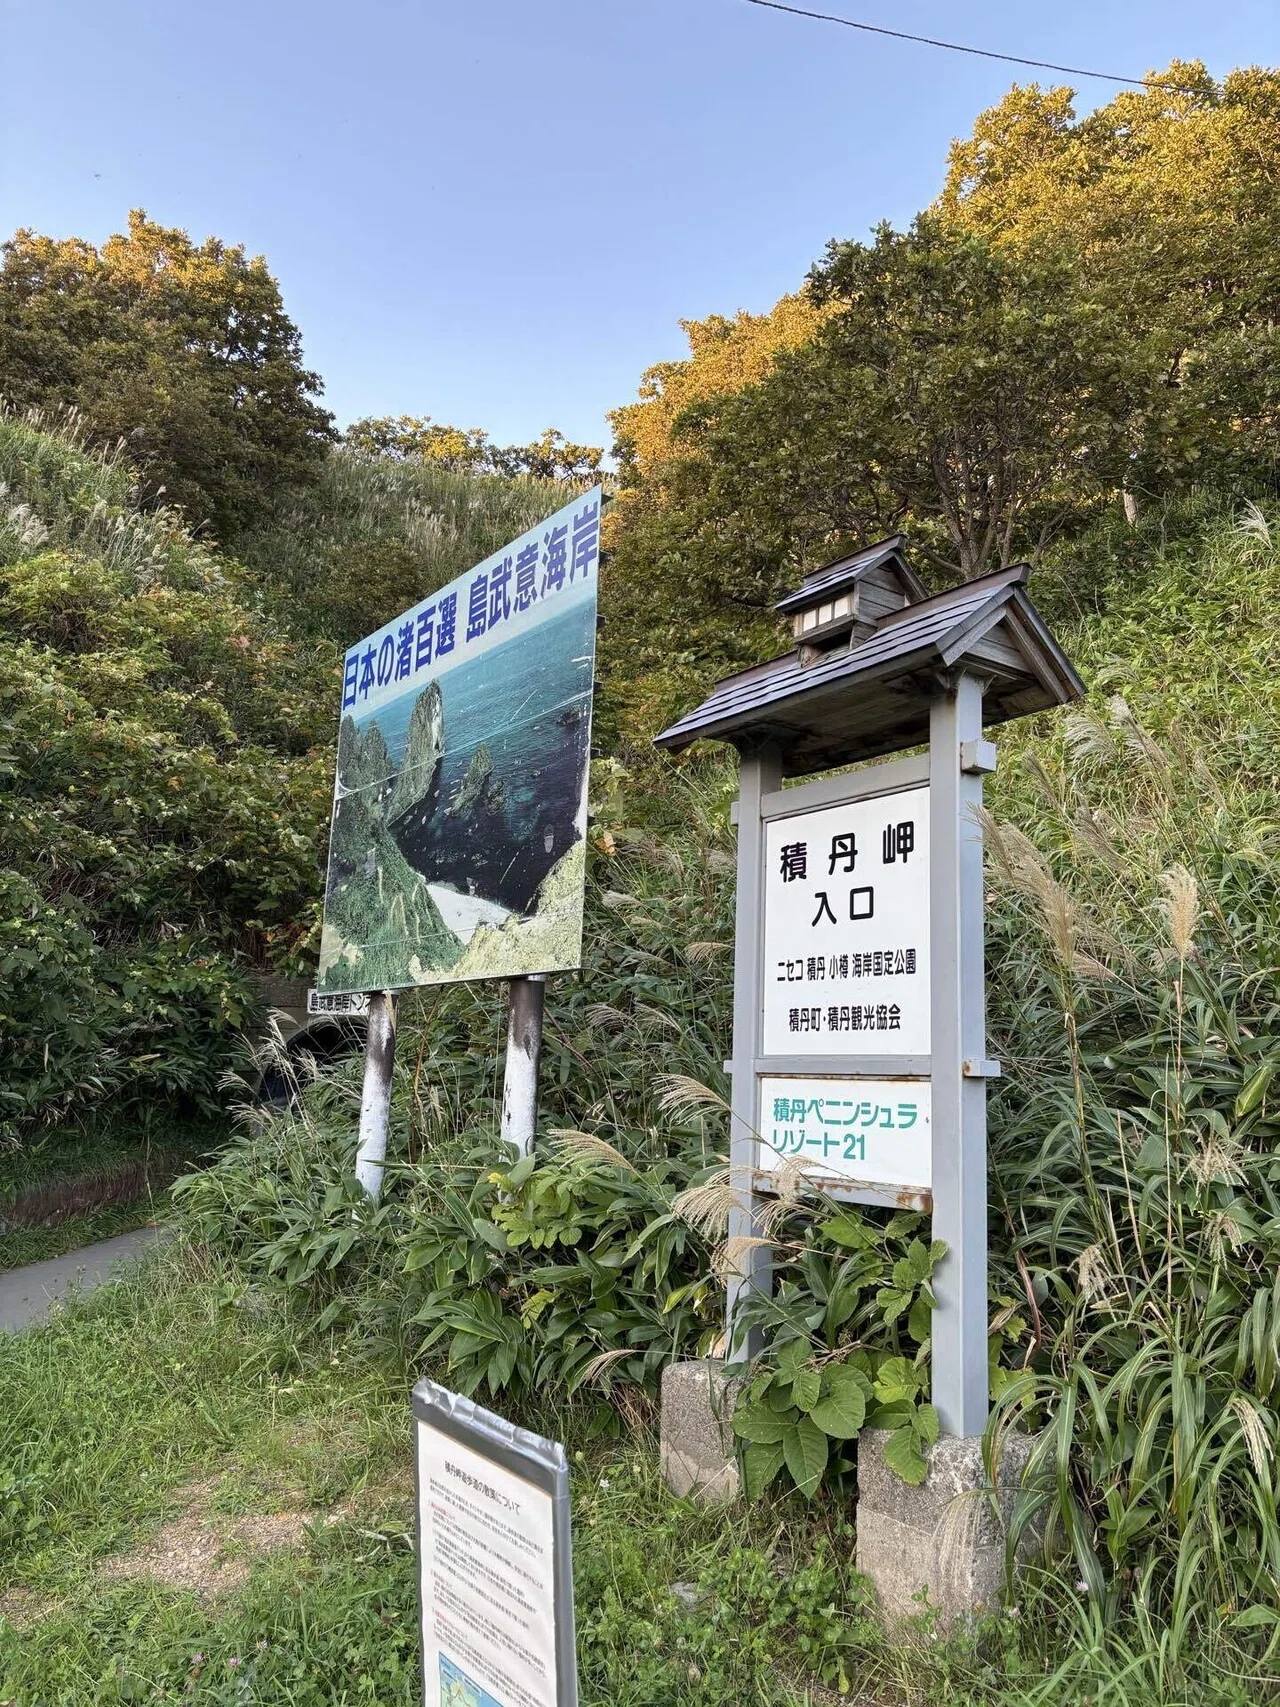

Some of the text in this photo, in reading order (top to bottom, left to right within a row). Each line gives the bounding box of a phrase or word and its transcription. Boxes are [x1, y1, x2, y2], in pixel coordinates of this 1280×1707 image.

[342, 501, 599, 711] 日本の渚百選 島武意海岸
[779, 820, 915, 883] 積丹岬
[811, 886, 875, 927] 入口
[773, 1097, 918, 1129] 積丹ペニンシュラ
